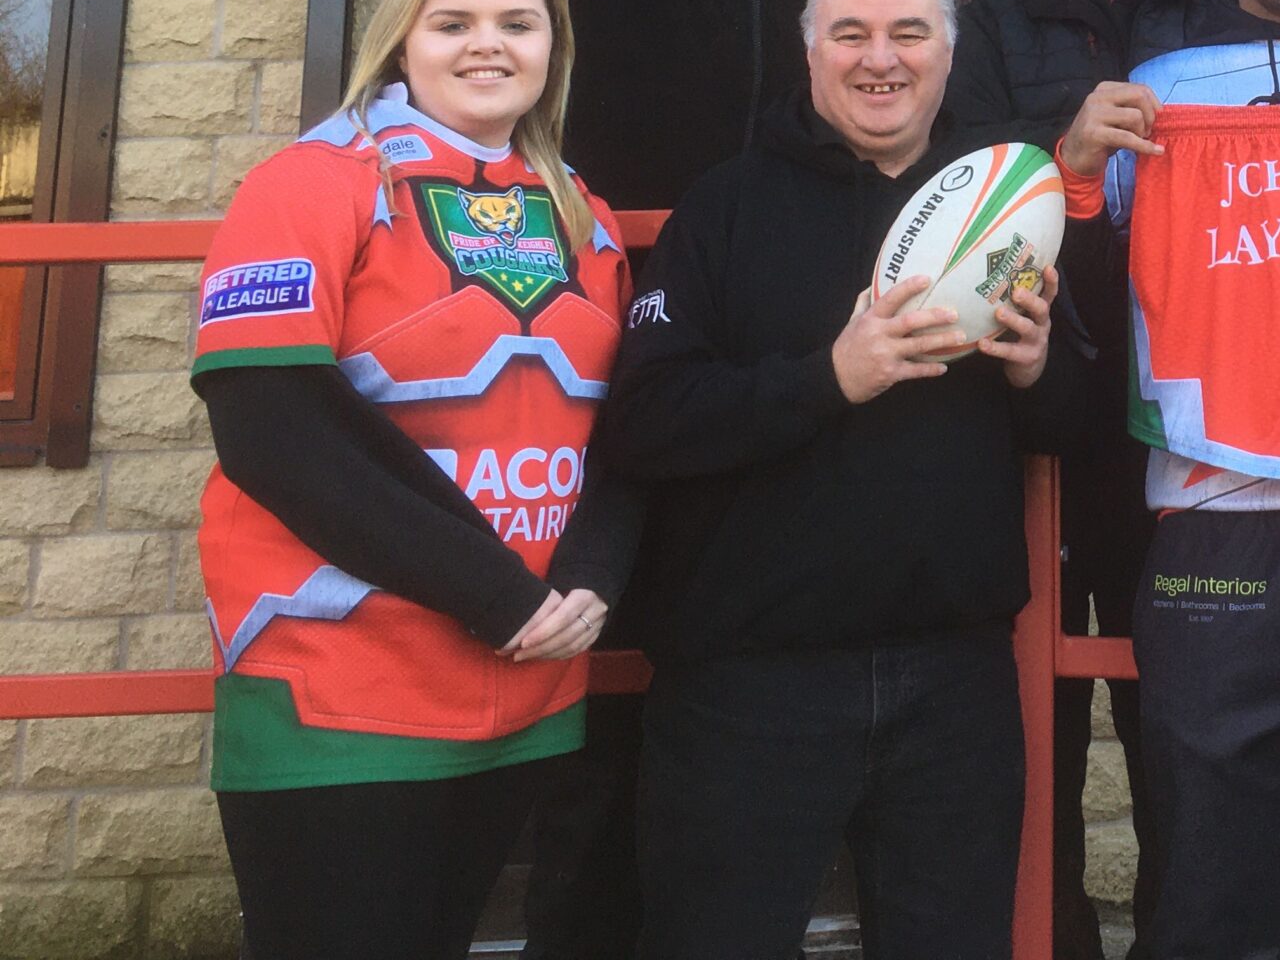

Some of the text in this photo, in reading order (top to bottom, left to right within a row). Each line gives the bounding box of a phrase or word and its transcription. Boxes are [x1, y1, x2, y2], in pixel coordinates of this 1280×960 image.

[453, 236, 482, 248] PRIDE
[482, 237, 497, 247] OF
[884, 192, 945, 284] RAVENSPORT
[206, 262, 310, 295] BETFRED
[456, 247, 566, 280] COUGARS
[215, 285, 305, 312] LEAGUE 1
[1154, 574, 1268, 597] Regal Interiors
